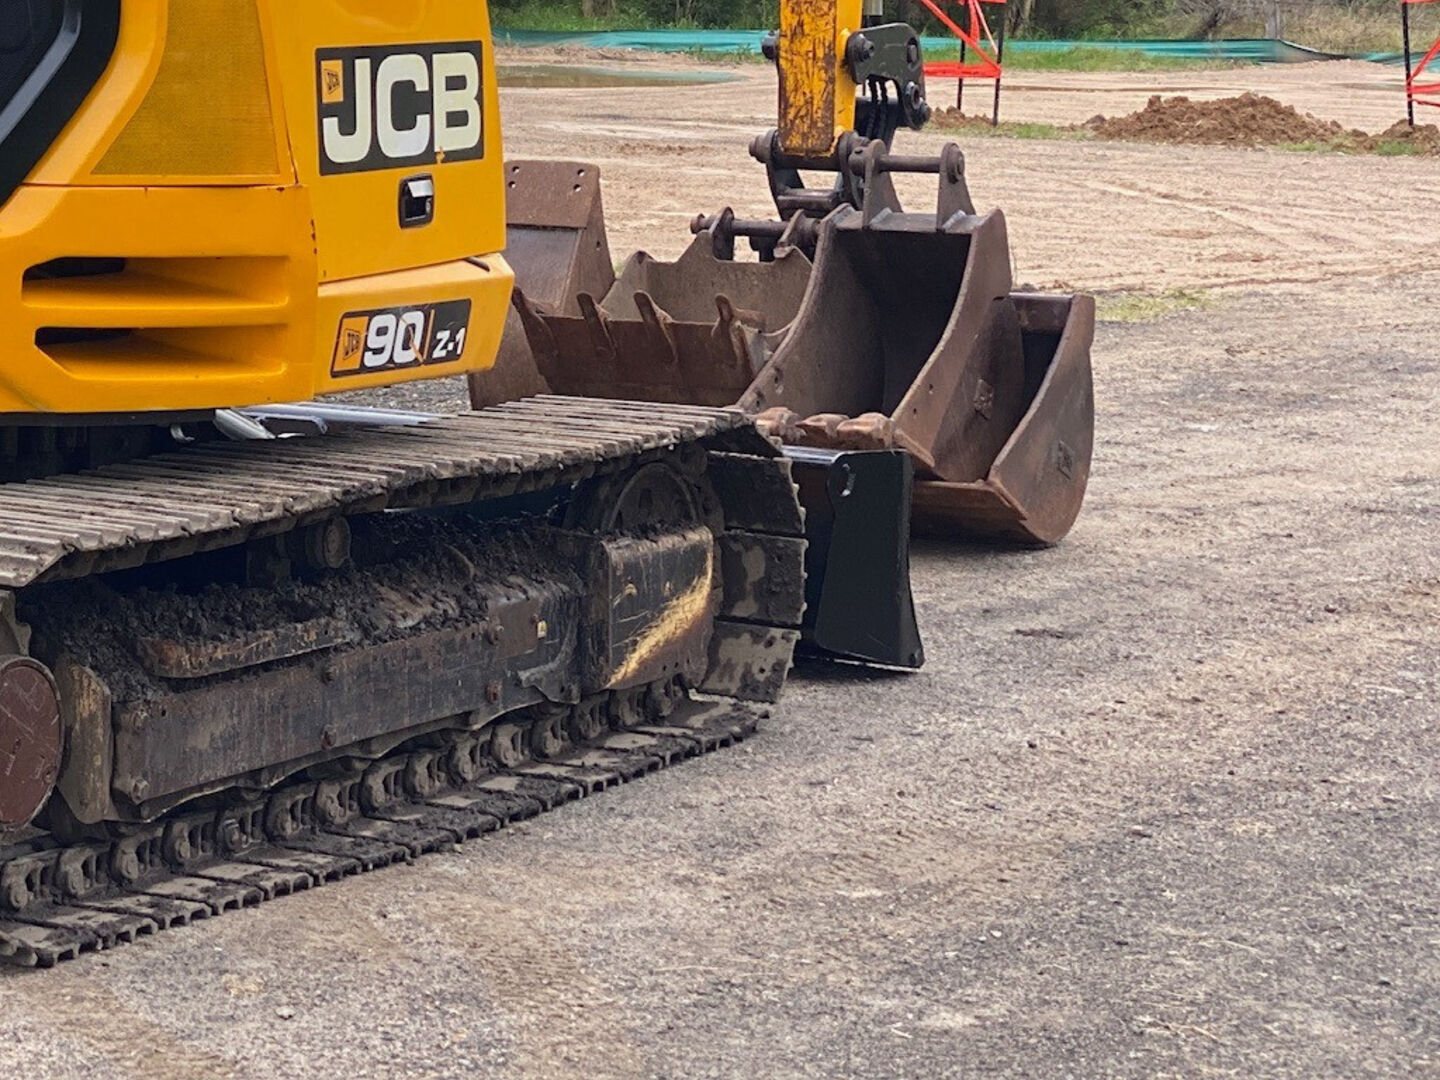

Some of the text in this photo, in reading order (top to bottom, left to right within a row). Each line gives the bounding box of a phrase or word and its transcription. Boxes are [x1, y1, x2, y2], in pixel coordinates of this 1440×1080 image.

[322, 51, 482, 163] JCB
[363, 310, 466, 367] 90 Z-1
